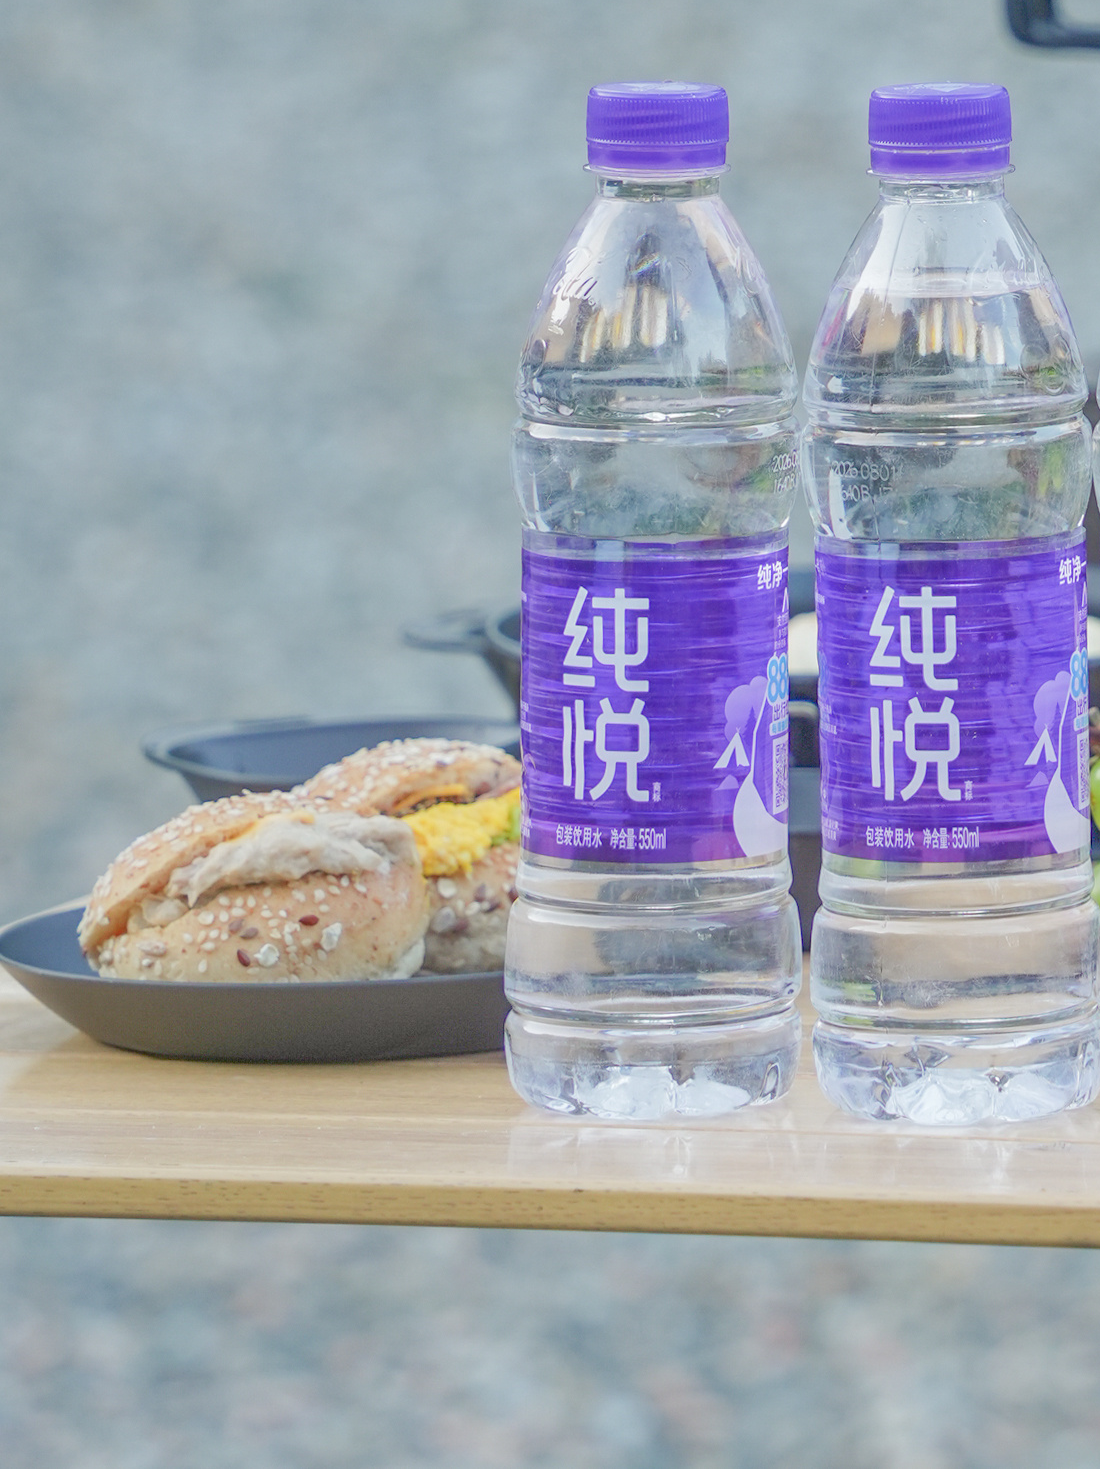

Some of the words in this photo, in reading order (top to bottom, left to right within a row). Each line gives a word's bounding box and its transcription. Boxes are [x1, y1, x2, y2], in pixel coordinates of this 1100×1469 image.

[563, 586, 649, 802] 纯悦
[869, 585, 962, 802] 纯悦
[556, 824, 602, 848] 包装饮用水
[866, 826, 914, 848] 包装饮用水
